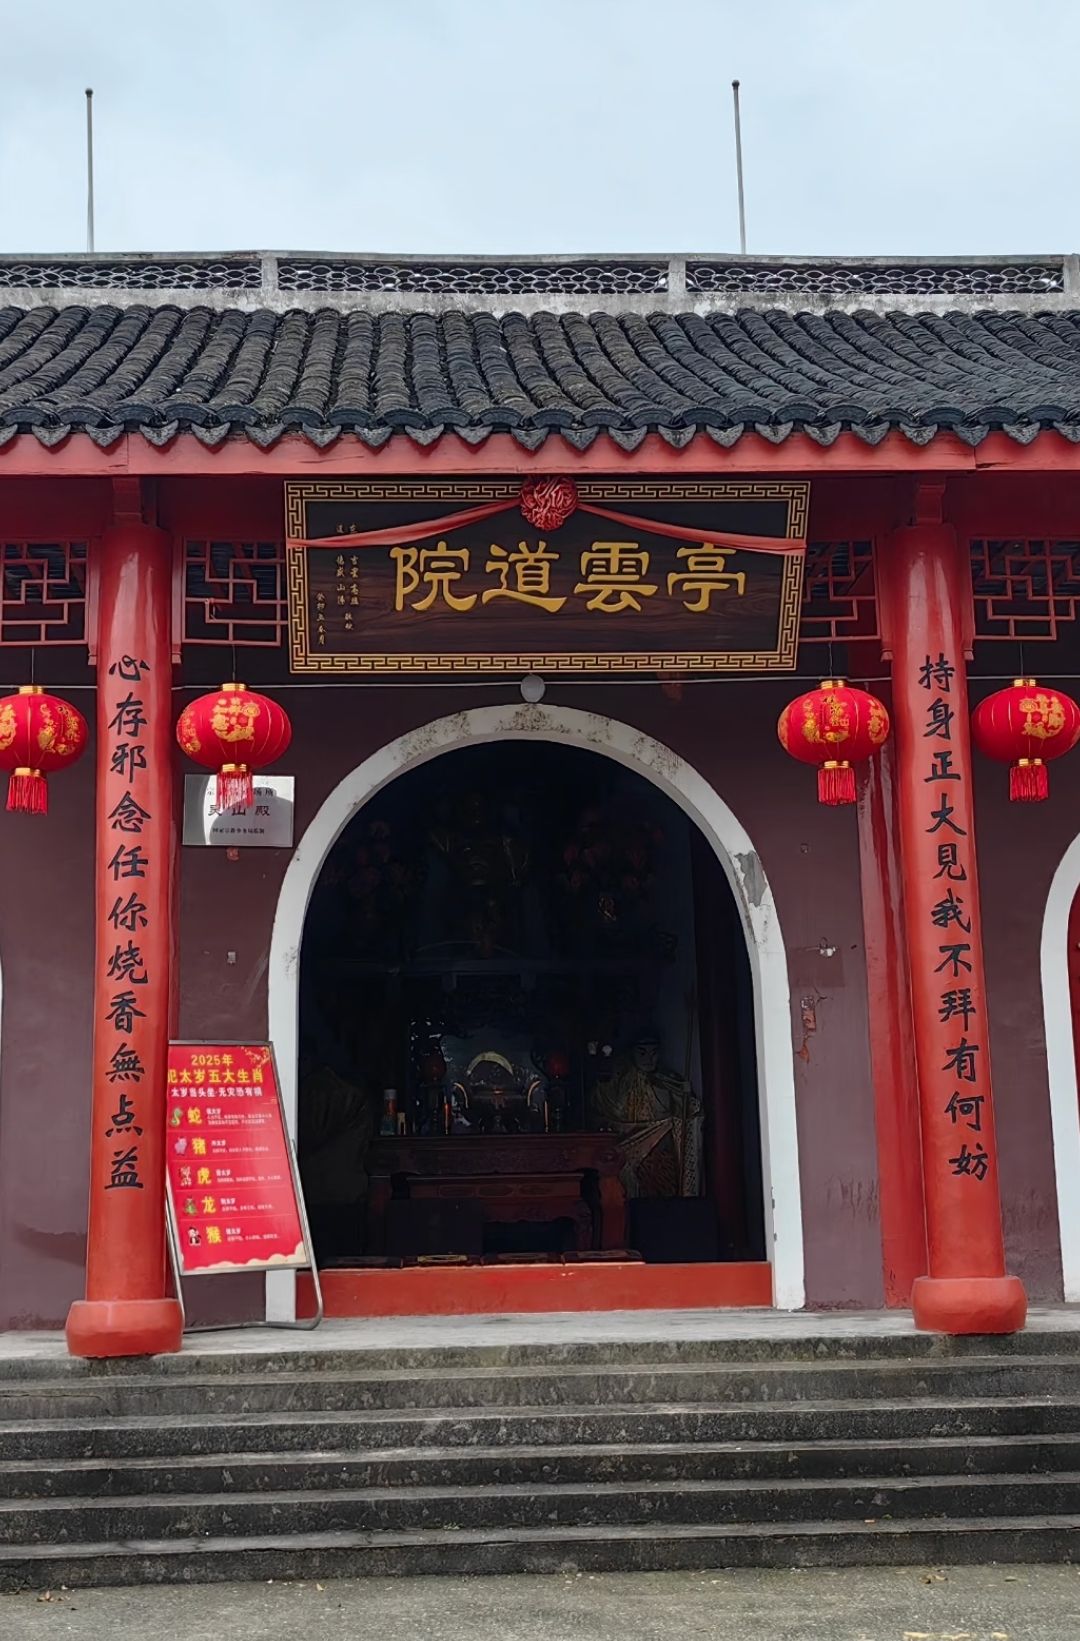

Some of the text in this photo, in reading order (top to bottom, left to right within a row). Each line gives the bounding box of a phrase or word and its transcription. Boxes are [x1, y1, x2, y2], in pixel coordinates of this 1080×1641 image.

[389, 540, 746, 613] 亭雲道院
[191, 1053, 234, 1067] 2025年
[187, 1106, 203, 1124] 蛇
[191, 1137, 207, 1155] 猪
[196, 1167, 212, 1185] 虎
[201, 1195, 216, 1214] 龙
[206, 1226, 222, 1244] 猴
